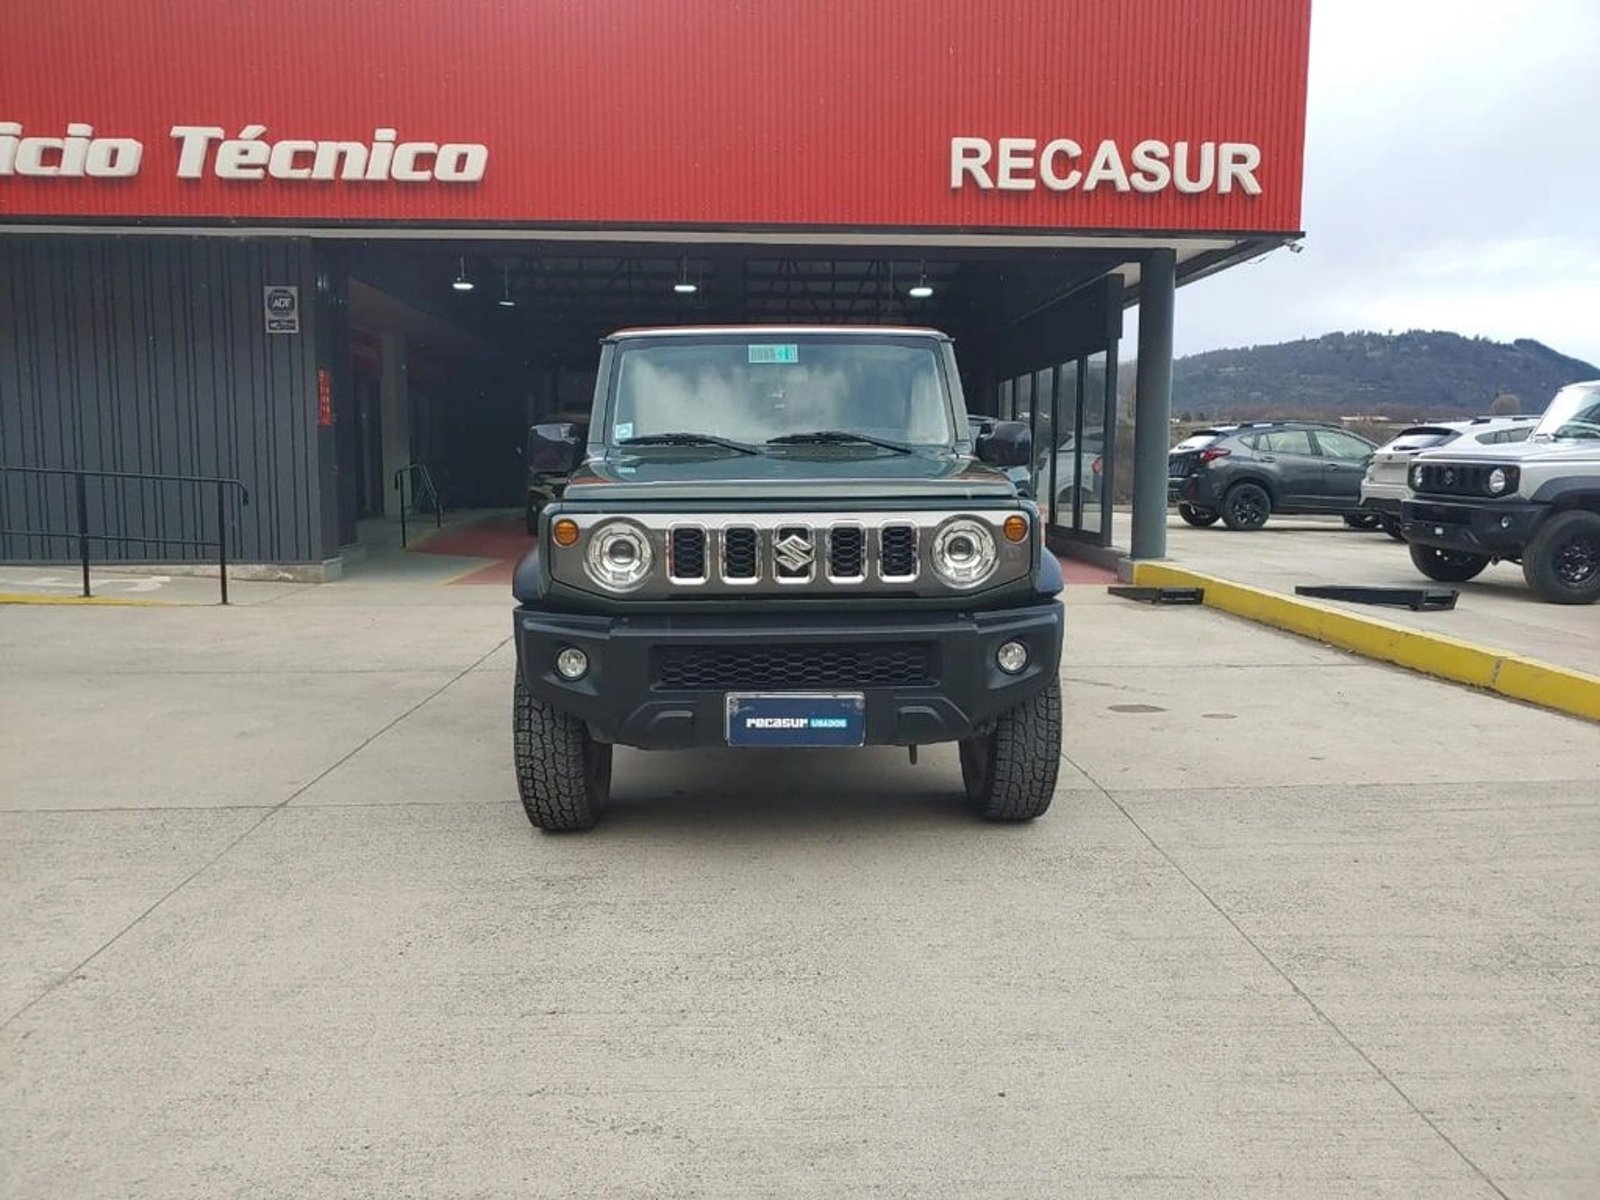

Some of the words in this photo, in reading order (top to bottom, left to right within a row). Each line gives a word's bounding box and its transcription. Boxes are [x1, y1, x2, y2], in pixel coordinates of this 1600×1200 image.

[170, 124, 488, 182] Técnico
[951, 137, 1263, 195] RECASUR
[746, 717, 808, 728] recasur
